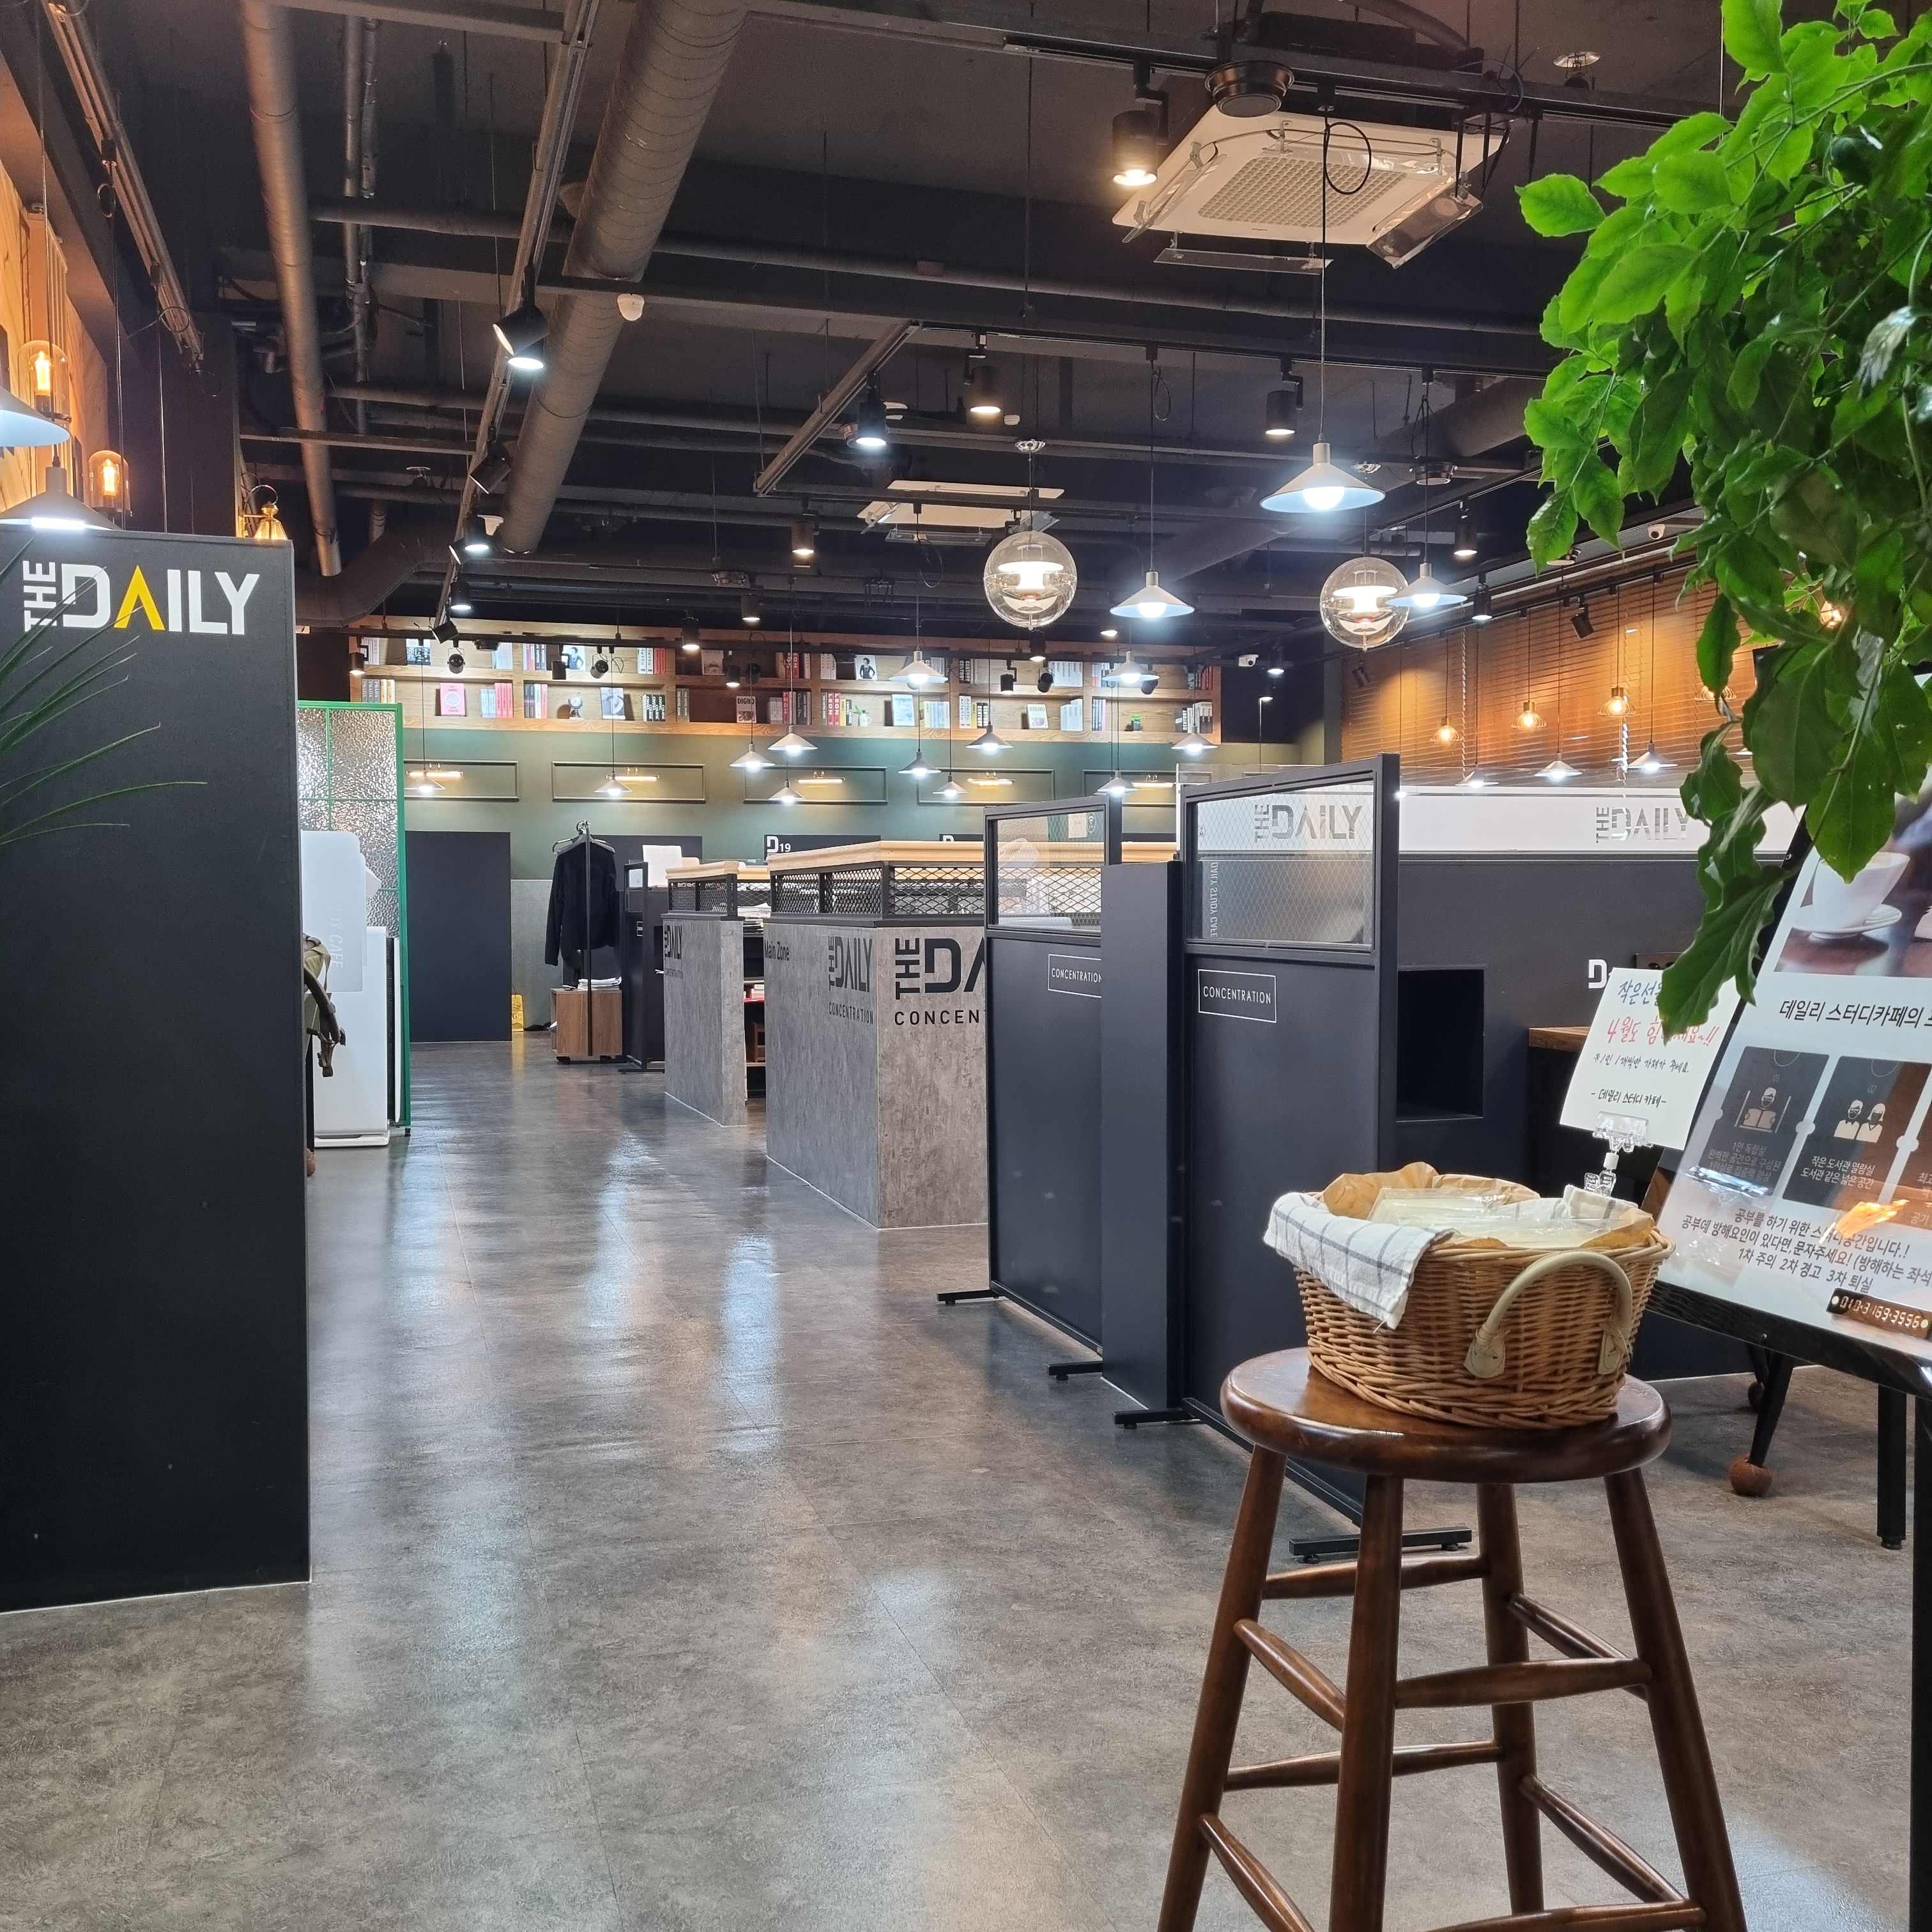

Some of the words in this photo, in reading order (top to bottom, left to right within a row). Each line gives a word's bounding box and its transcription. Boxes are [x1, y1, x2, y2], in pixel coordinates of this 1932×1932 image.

[22, 560, 57, 632] THE
[61, 562, 261, 636] DAILY
[1254, 804, 1269, 843] THE
[1271, 804, 1363, 839] DAILY
[1596, 807, 1609, 843] THE
[1611, 807, 1689, 841] DAILY
[764, 940, 776, 959] Main
[777, 941, 790, 961] Zone
[835, 936, 873, 993] DAILY
[895, 937, 921, 1000] THE
[1588, 959, 1612, 989] D
[1202, 986, 1271, 1005] CONCENTRATION
[829, 1001, 874, 1025] CONCENTRATION
[894, 1009, 985, 1026] CONCEN
[1779, 999, 1826, 1022] 데일리
[1825, 1004, 1924, 1029] 스터디카페의
[1598, 1089, 1621, 1103] 데일리
[1621, 1091, 1643, 1105] 스터디
[1729, 1153, 1758, 1166] 공간으로
[1812, 1155, 1827, 1168] 작은
[1827, 1159, 1851, 1172] 도서관
[1851, 1162, 1876, 1176] 열람실
[1800, 1167, 1825, 1181] 도서관
[1824, 1170, 1840, 1184] 같은
[1840, 1174, 1857, 1186] 넓은
[1857, 1176, 1874, 1190] 공간
[1734, 1208, 1766, 1228] 공부를
[1767, 1215, 1789, 1234] 하기
[1788, 1220, 1811, 1238] 위한
[1712, 1220, 1760, 1246] 방해요인이
[1853, 1255, 1905, 1280] (방해하는
[1738, 1248, 1755, 1265] 1차
[1755, 1252, 1777, 1269] 주의
[1779, 1259, 1798, 1275] 2차
[1800, 1261, 1822, 1280] 경고
[1825, 1269, 1848, 1287] 3차
[1848, 1275, 1874, 1294] 퇴실
